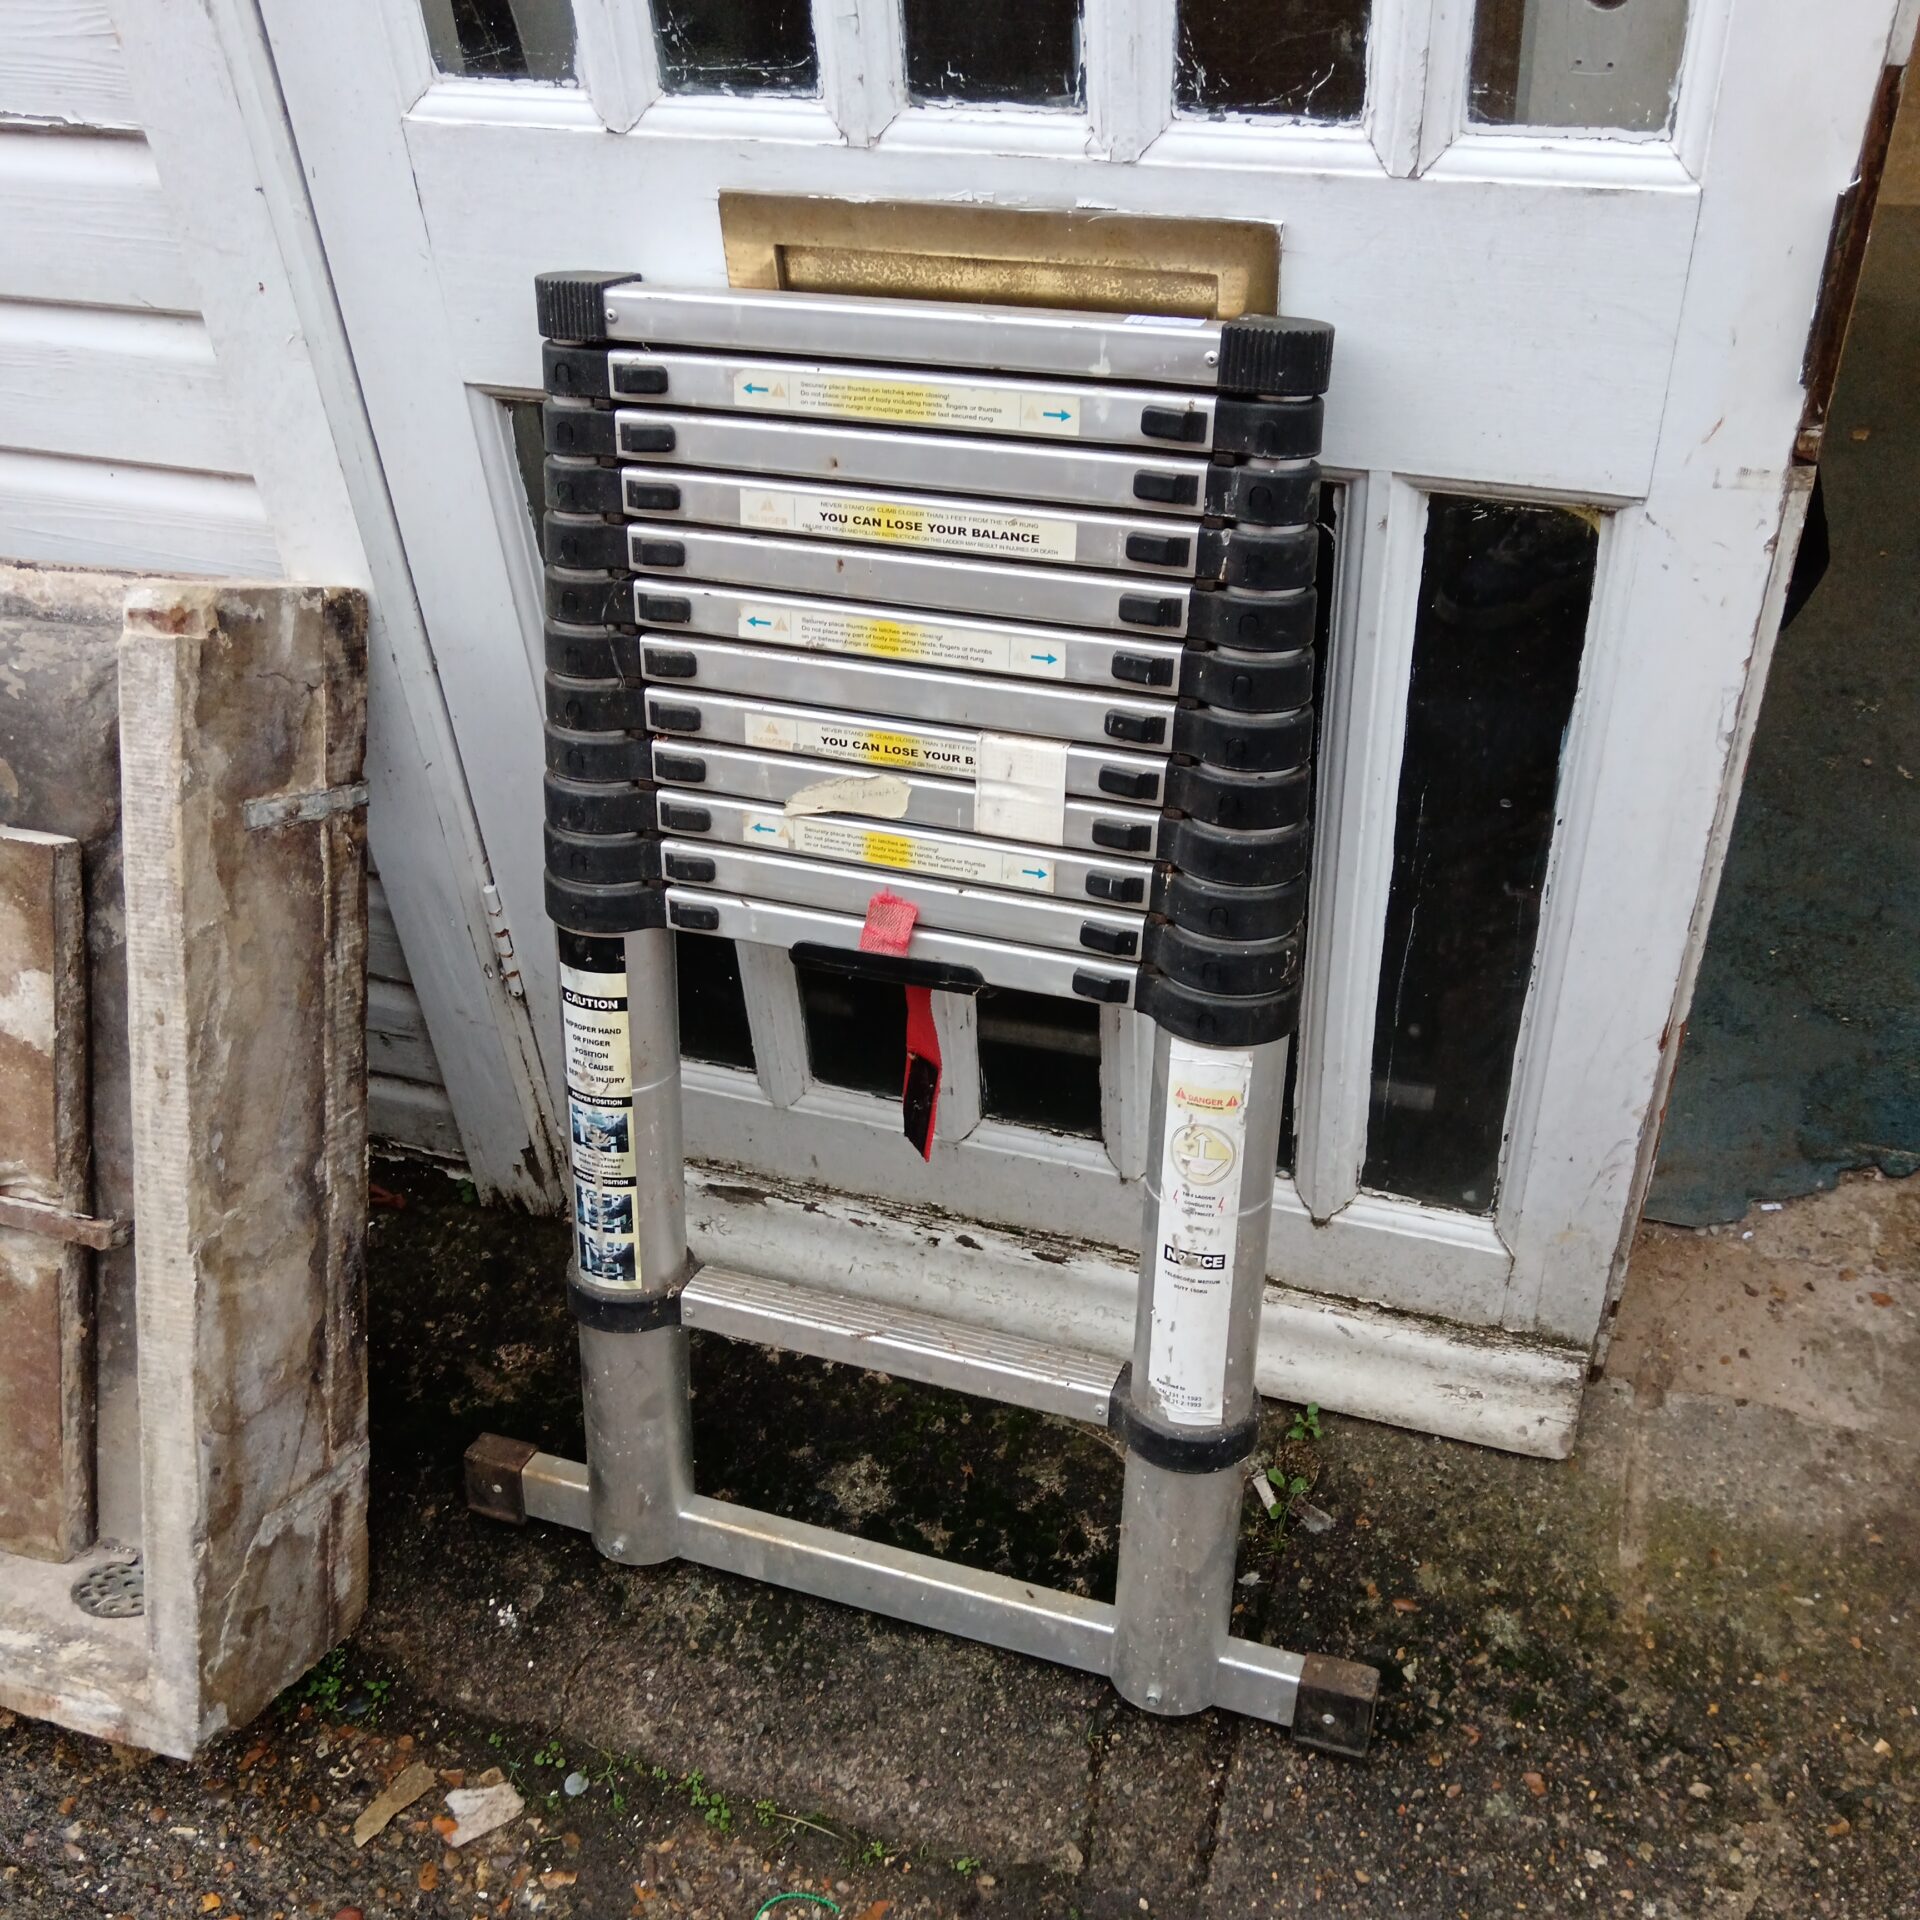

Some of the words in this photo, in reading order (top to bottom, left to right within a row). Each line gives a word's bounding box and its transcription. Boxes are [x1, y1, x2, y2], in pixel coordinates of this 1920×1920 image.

[875, 396, 890, 404] body
[893, 398, 921, 407] including
[897, 509, 924, 517] CLOSER
[819, 512, 847, 523] YOU
[852, 515, 881, 527] CAN
[886, 519, 922, 531] LOSE
[927, 523, 966, 536] YOUR
[972, 528, 1039, 543] BALANCE
[872, 634, 887, 642] body
[939, 643, 959, 651] fingers
[969, 647, 992, 655] thumbs
[821, 726, 842, 734] NEVER
[922, 739, 938, 747] THAN
[820, 736, 847, 748] YOU
[852, 740, 879, 752] CAN
[884, 744, 918, 758] LOSE
[923, 750, 960, 763] YOUR
[935, 855, 955, 863] fingers
[963, 859, 986, 868] thumbs
[565, 991, 617, 1010] CAUTION
[582, 1037, 610, 1047] FINGER
[575, 1047, 609, 1059] POSITION
[588, 1062, 614, 1071] CAUSE
[596, 1076, 625, 1084] INJURY
[592, 1098, 622, 1106] POSITION
[1188, 1094, 1223, 1106] DANGER
